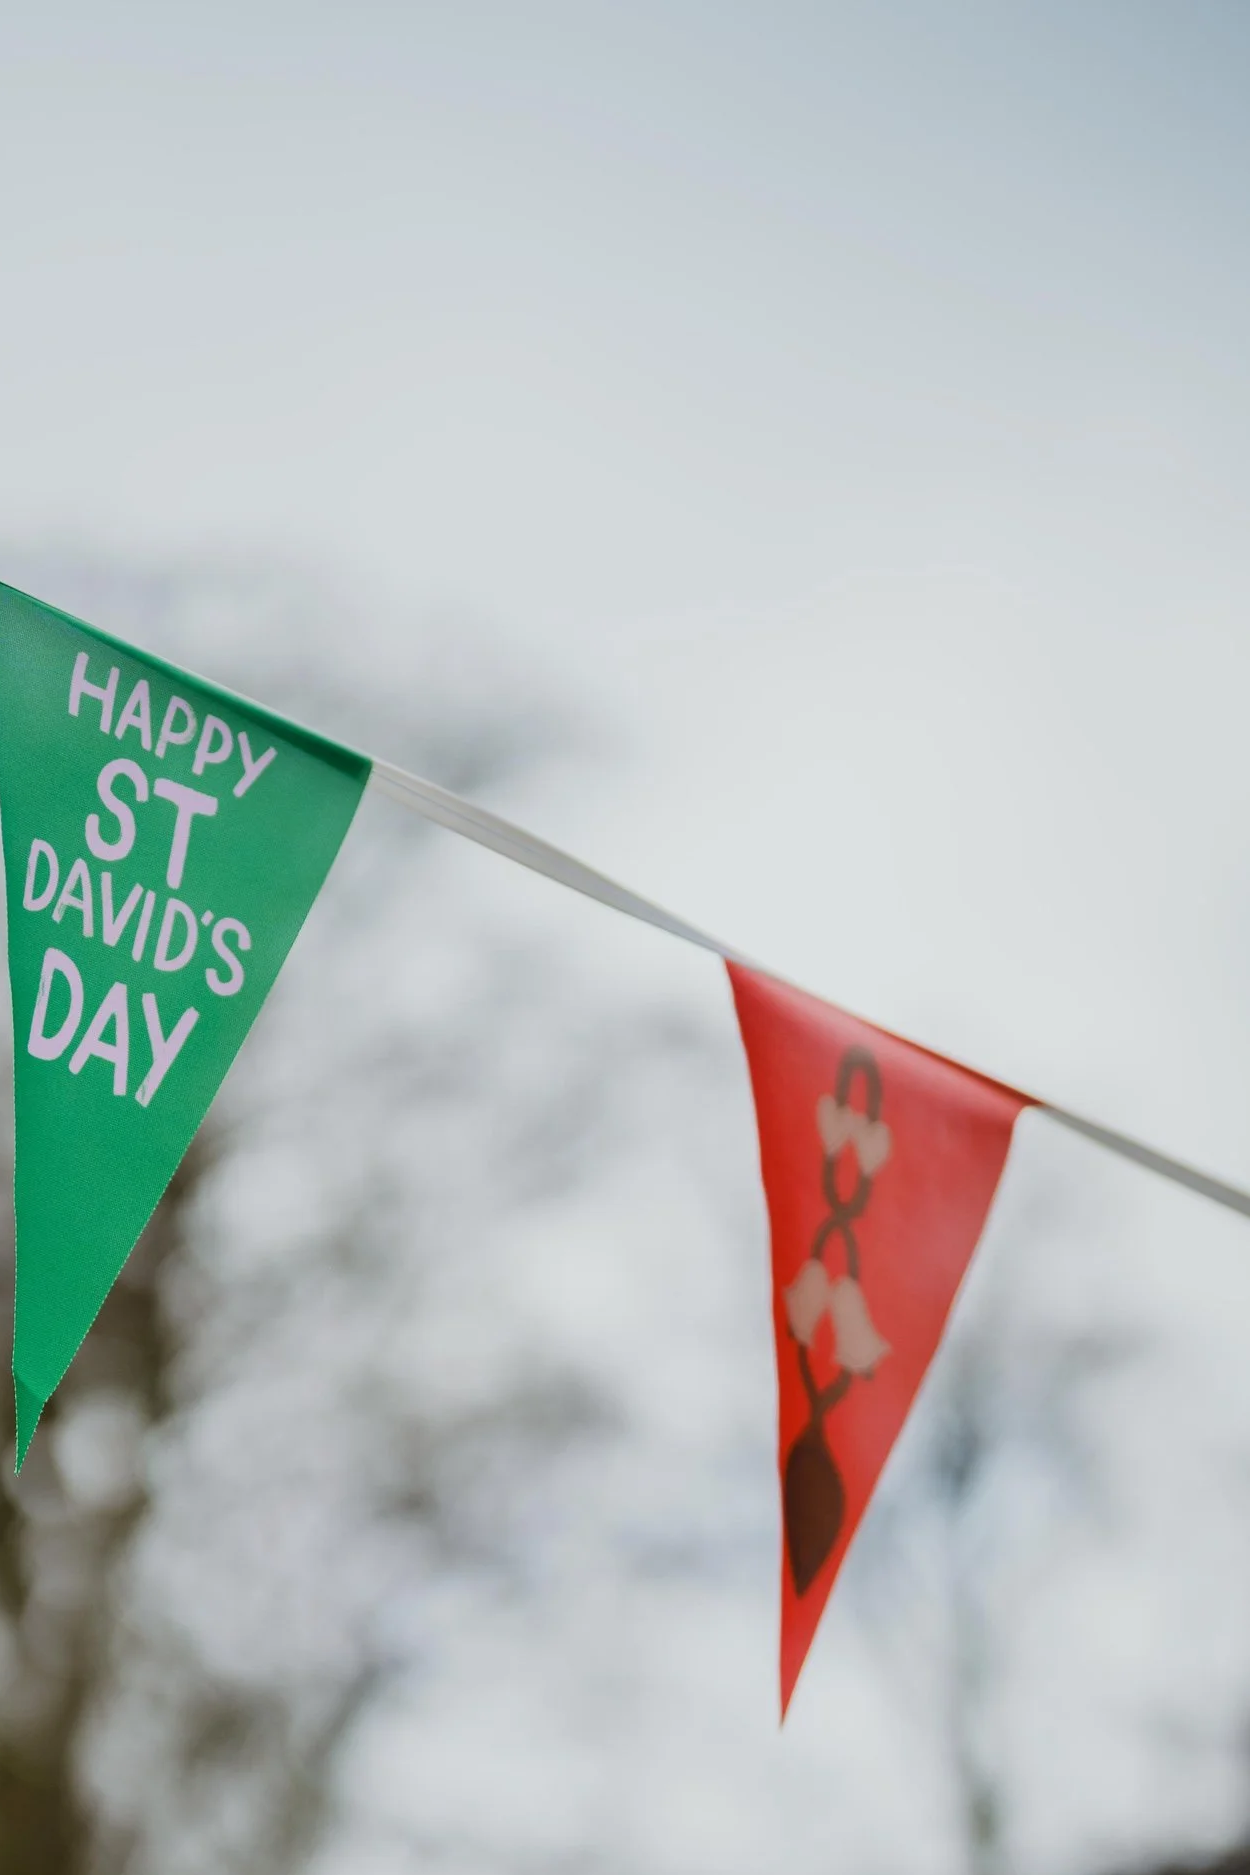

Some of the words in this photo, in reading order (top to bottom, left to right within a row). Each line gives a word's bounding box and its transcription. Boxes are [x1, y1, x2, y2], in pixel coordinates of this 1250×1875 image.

[68, 652, 278, 798] HAPPY
[85, 758, 218, 889] ST
[22, 838, 251, 996] DAVID'S
[27, 947, 200, 1108] DAY
